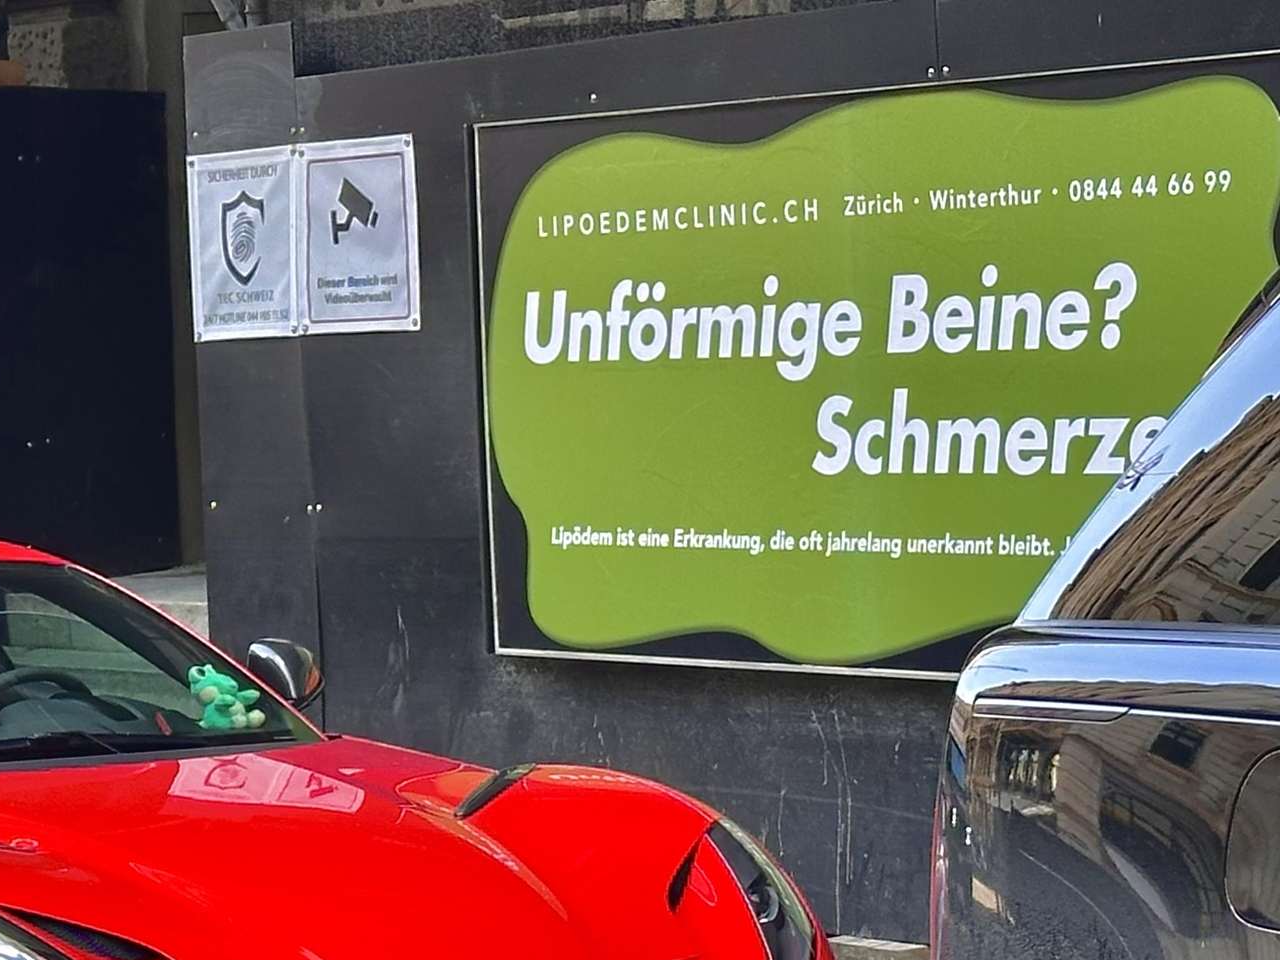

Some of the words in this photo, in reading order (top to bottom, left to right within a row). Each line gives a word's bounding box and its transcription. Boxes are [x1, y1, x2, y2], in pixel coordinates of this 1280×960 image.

[538, 198, 819, 237] LIPOEDEMCLINIC.CH
[843, 193, 904, 216] Zürich
[929, 183, 1042, 211] Winterthur
[1068, 177, 1122, 202] 0844
[1131, 175, 1158, 197] 44
[1168, 173, 1195, 196] 66
[1204, 170, 1232, 193] 99
[236, 289, 274, 304] SCHWEIZ
[317, 277, 346, 289] Dieser
[347, 274, 380, 288] Bereich
[380, 273, 398, 286] wird
[523, 275, 862, 381] Unförmige
[886, 262, 1138, 353] Beine?
[551, 525, 613, 550] Lipödem
[616, 526, 635, 547] ist
[638, 528, 669, 547] eine
[673, 528, 766, 555] Erkrankung,
[769, 530, 795, 551] die
[798, 530, 823, 552] oft
[825, 531, 902, 558] jahrelang
[907, 532, 994, 555] unerkannt
[998, 534, 1055, 556] bleibt.
